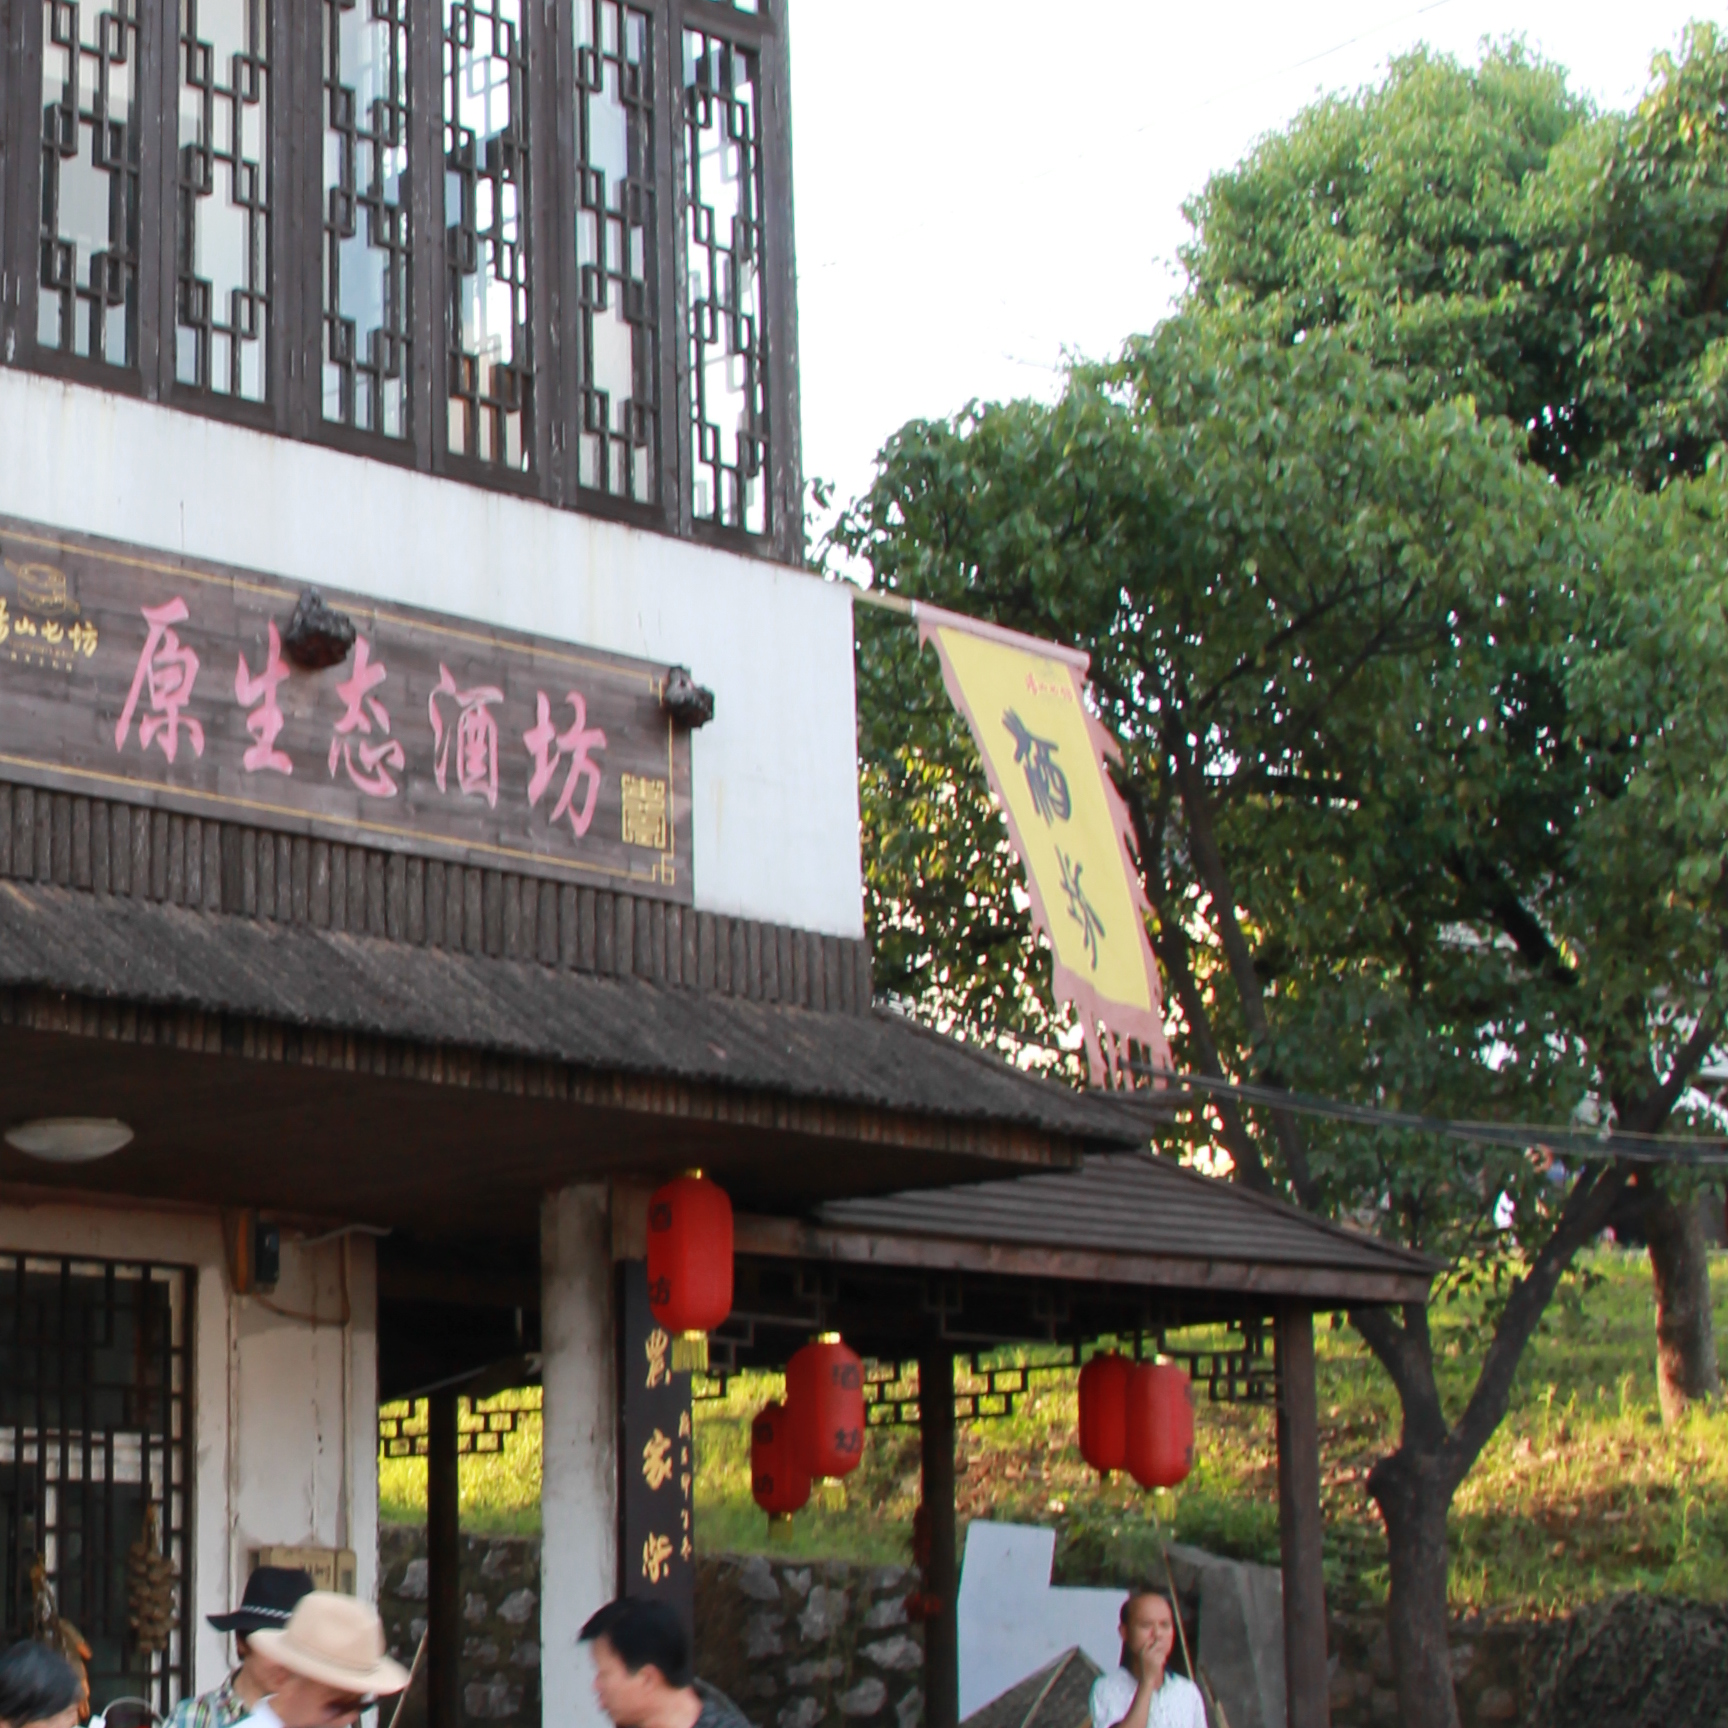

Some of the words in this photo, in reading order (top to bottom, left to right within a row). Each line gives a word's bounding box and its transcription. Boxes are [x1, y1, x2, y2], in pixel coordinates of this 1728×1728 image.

[114, 597, 607, 837] 原生态酒坊
[1001, 706, 1105, 973] 酒坊
